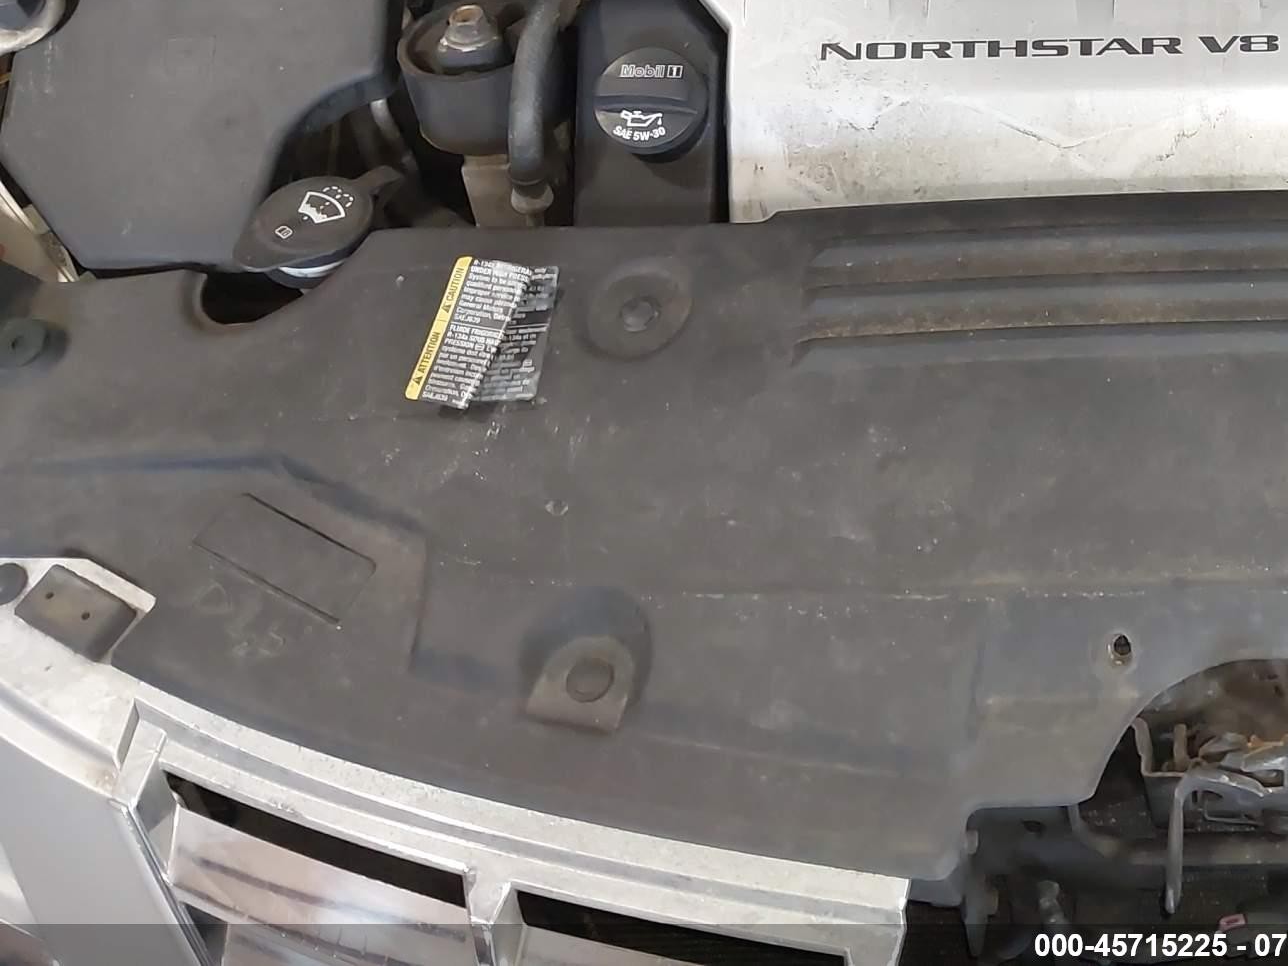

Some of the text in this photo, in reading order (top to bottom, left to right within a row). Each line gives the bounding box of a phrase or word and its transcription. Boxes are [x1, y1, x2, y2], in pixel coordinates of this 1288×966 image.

[820, 36, 1184, 60] NORTHSTAR
[1200, 34, 1280, 54] V8
[620, 64, 666, 78] Mobil
[612, 125, 666, 141] SAE 5W-30
[446, 267, 465, 302] CAUTION
[417, 331, 441, 374] ATTENTION
